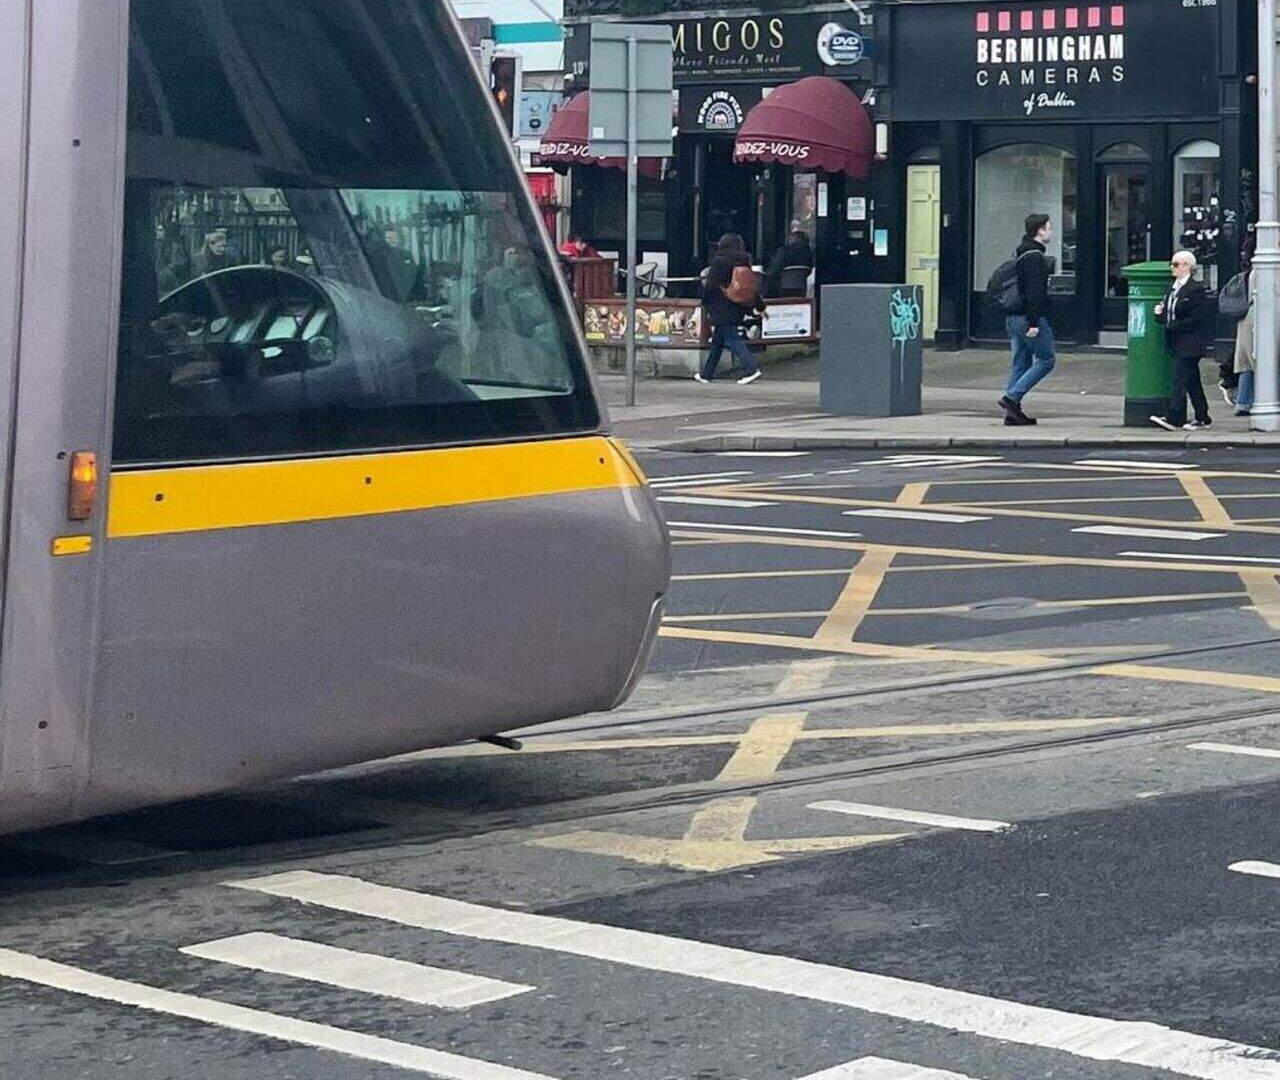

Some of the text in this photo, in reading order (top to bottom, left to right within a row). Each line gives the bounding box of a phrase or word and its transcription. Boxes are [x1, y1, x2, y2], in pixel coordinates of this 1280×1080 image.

[832, 36, 859, 46] DVD
[976, 34, 1124, 64] BERMINGHAM
[976, 66, 1124, 87] CAMERAS
[1023, 91, 1076, 115] of Dublin
